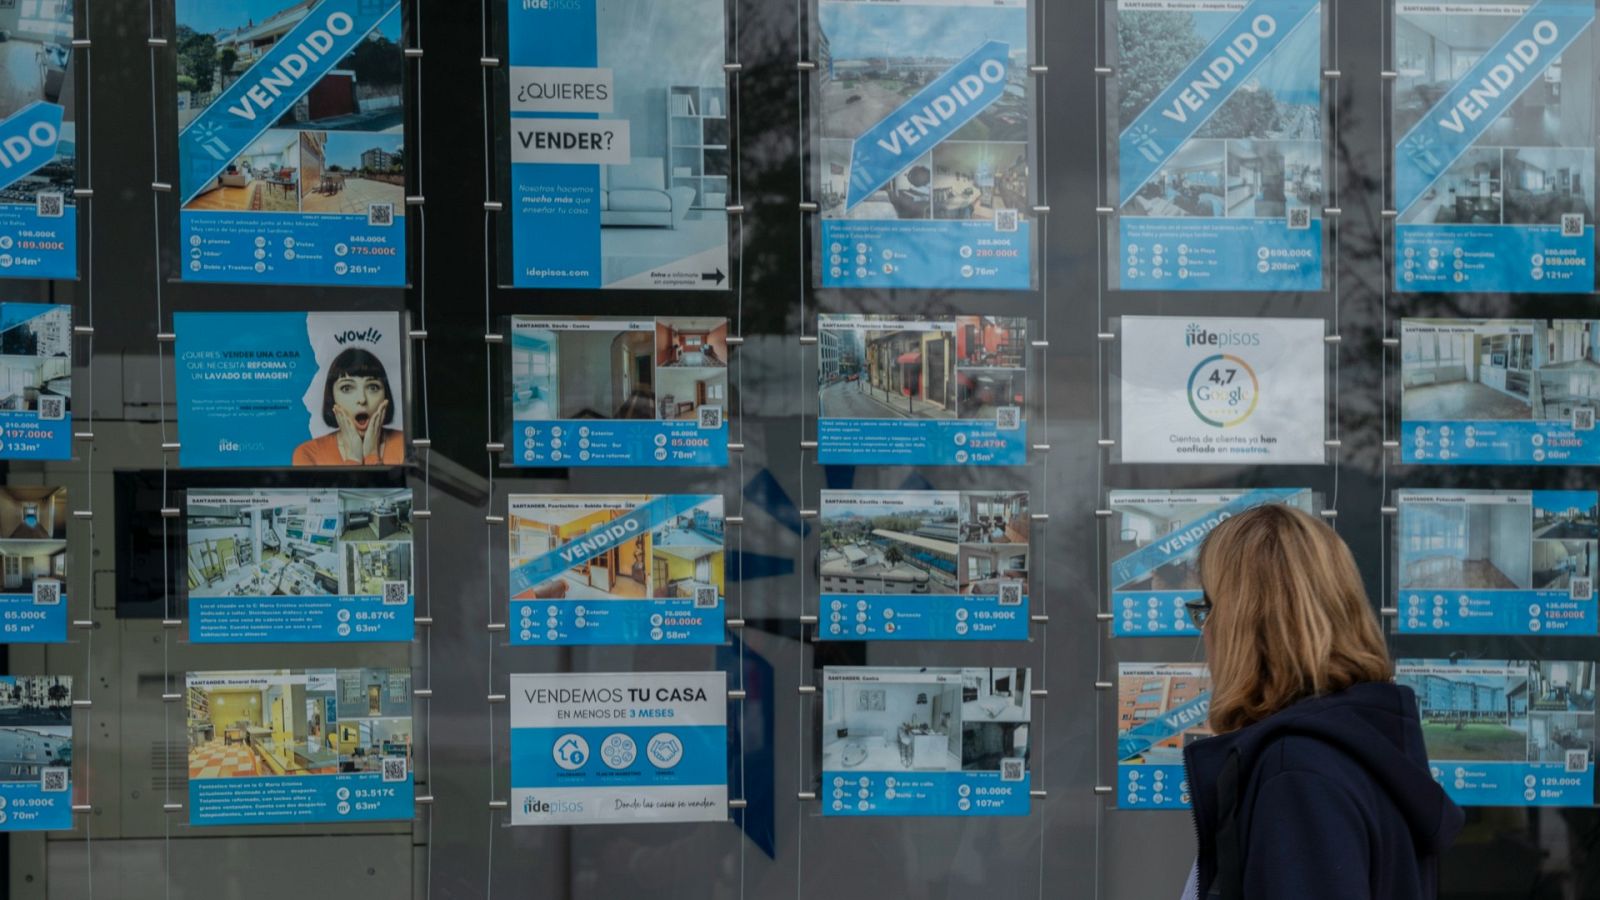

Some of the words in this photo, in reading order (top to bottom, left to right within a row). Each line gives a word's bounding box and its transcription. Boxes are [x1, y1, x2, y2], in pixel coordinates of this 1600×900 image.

[228, 11, 354, 122] VENDIDO
[1161, 14, 1276, 124] VENDIDO
[1439, 20, 1559, 134] VENDIDO
[517, 82, 608, 103] ¿QUIERES
[876, 59, 1005, 157] VENDIDO
[0, 120, 57, 168] IDO
[518, 130, 614, 151] VENDER?
[519, 184, 554, 193] Nosotros
[556, 186, 594, 194] hacemos
[522, 195, 552, 203] mucho
[553, 195, 573, 204] más
[575, 197, 591, 206] que
[522, 205, 556, 214] enseñar
[351, 246, 396, 256] 775.000€
[526, 267, 589, 280] idepisos.com
[333, 327, 382, 345] WOW!!!
[182, 351, 221, 361] ¿QUIERES
[223, 350, 254, 358] VENDER
[256, 351, 274, 359] UNA
[276, 351, 300, 359] CASA
[187, 361, 204, 370] QUE
[207, 361, 245, 369] NECESITA
[247, 361, 287, 369] REFORMA
[191, 372, 203, 380] UN
[204, 372, 240, 380] LAVADO
[242, 372, 252, 380] DE
[254, 371, 292, 380] IMAGEN?
[1208, 368, 1236, 387] 4,7
[1196, 385, 1249, 407] Google
[6, 430, 54, 439] 197.000€
[1169, 434, 1201, 444] Cientos
[1203, 435, 1213, 444] de
[1215, 435, 1247, 444] clientes
[1248, 437, 1259, 446] ya
[1260, 435, 1277, 444] han
[1176, 444, 1215, 454] confiado
[1230, 446, 1271, 455] nosotros.
[559, 518, 639, 563] VENDIDO
[4, 611, 47, 619] 65.000€
[4, 624, 18, 633] 65
[524, 687, 623, 704] VENDEMOS
[627, 687, 651, 702] TU
[655, 686, 707, 702] CASA
[557, 710, 571, 719] EN
[573, 709, 611, 720] MENOS
[613, 708, 627, 719] DE
[629, 708, 636, 718] 3
[638, 707, 675, 718] MESES
[1166, 700, 1210, 728] VEND
[355, 788, 395, 798] 93.517€
[614, 797, 643, 810] Donde
[643, 797, 657, 809] las
[656, 800, 676, 809] casas
[677, 801, 688, 809] se
[688, 797, 715, 808] venden
